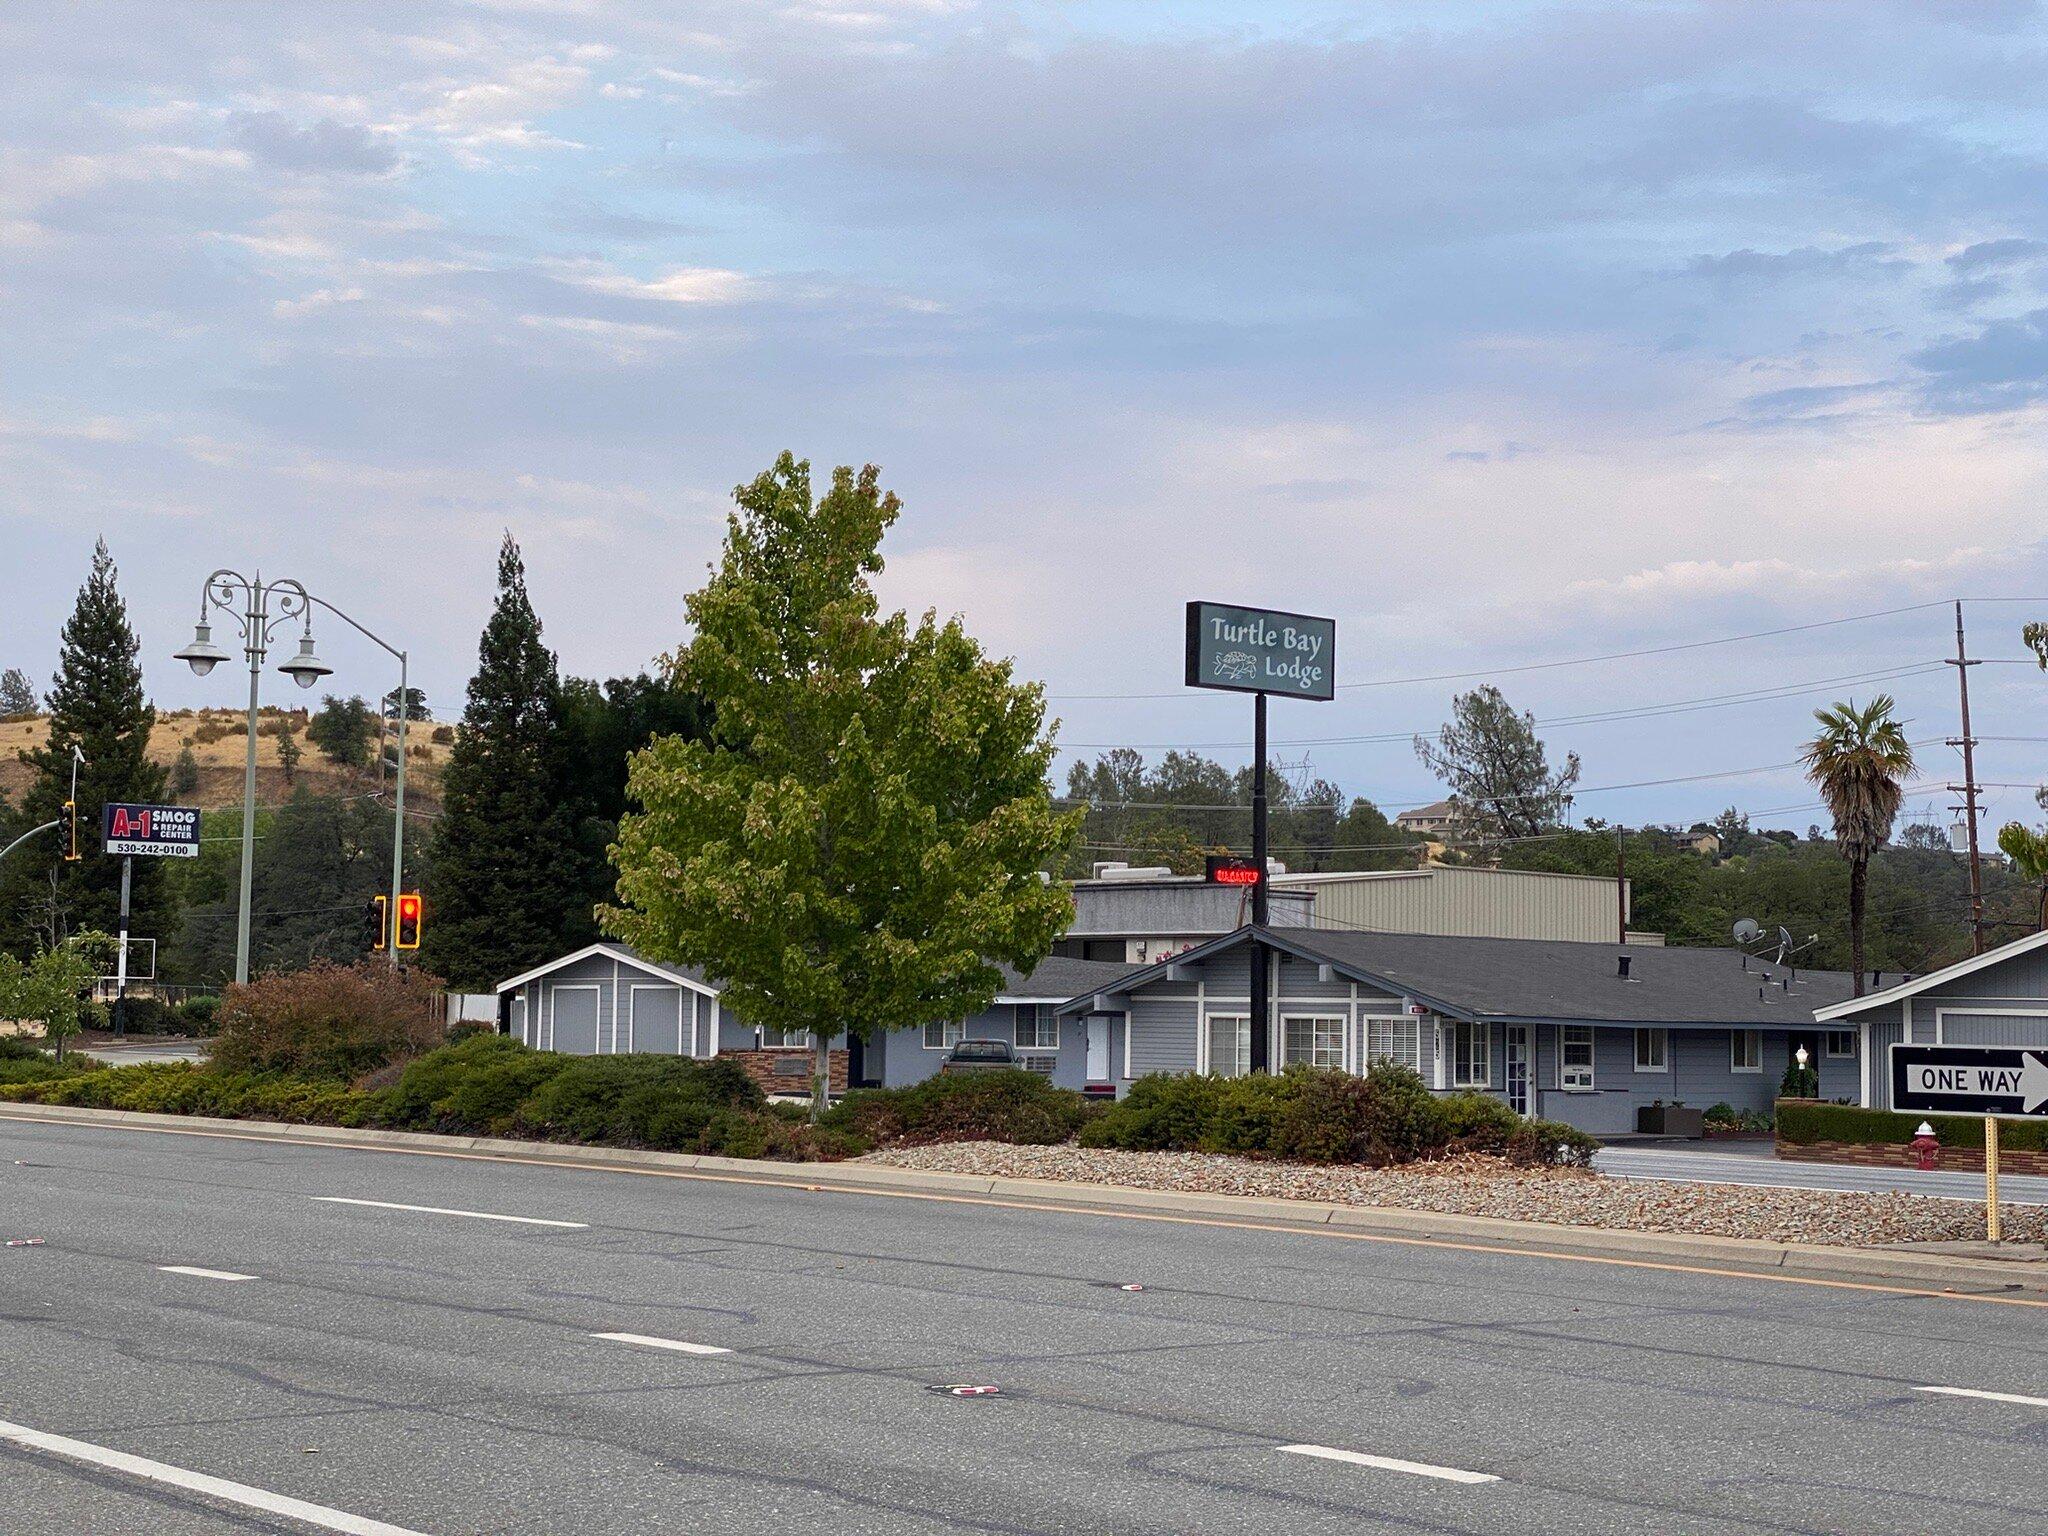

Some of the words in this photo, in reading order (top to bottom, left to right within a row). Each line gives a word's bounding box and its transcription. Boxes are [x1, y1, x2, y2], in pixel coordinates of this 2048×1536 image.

[1210, 617, 1277, 647] Turtle
[1282, 627, 1322, 662] Bay
[1265, 656, 1322, 689] Lodge
[111, 808, 151, 838] A-1
[152, 810, 196, 824] SMOG
[160, 823, 192, 832] REPAIR
[160, 831, 192, 839] CENTER
[117, 843, 188, 855] 530-242-0100
[1921, 1068, 1968, 1091] ONE
[1978, 1070, 2023, 1093] WAY
